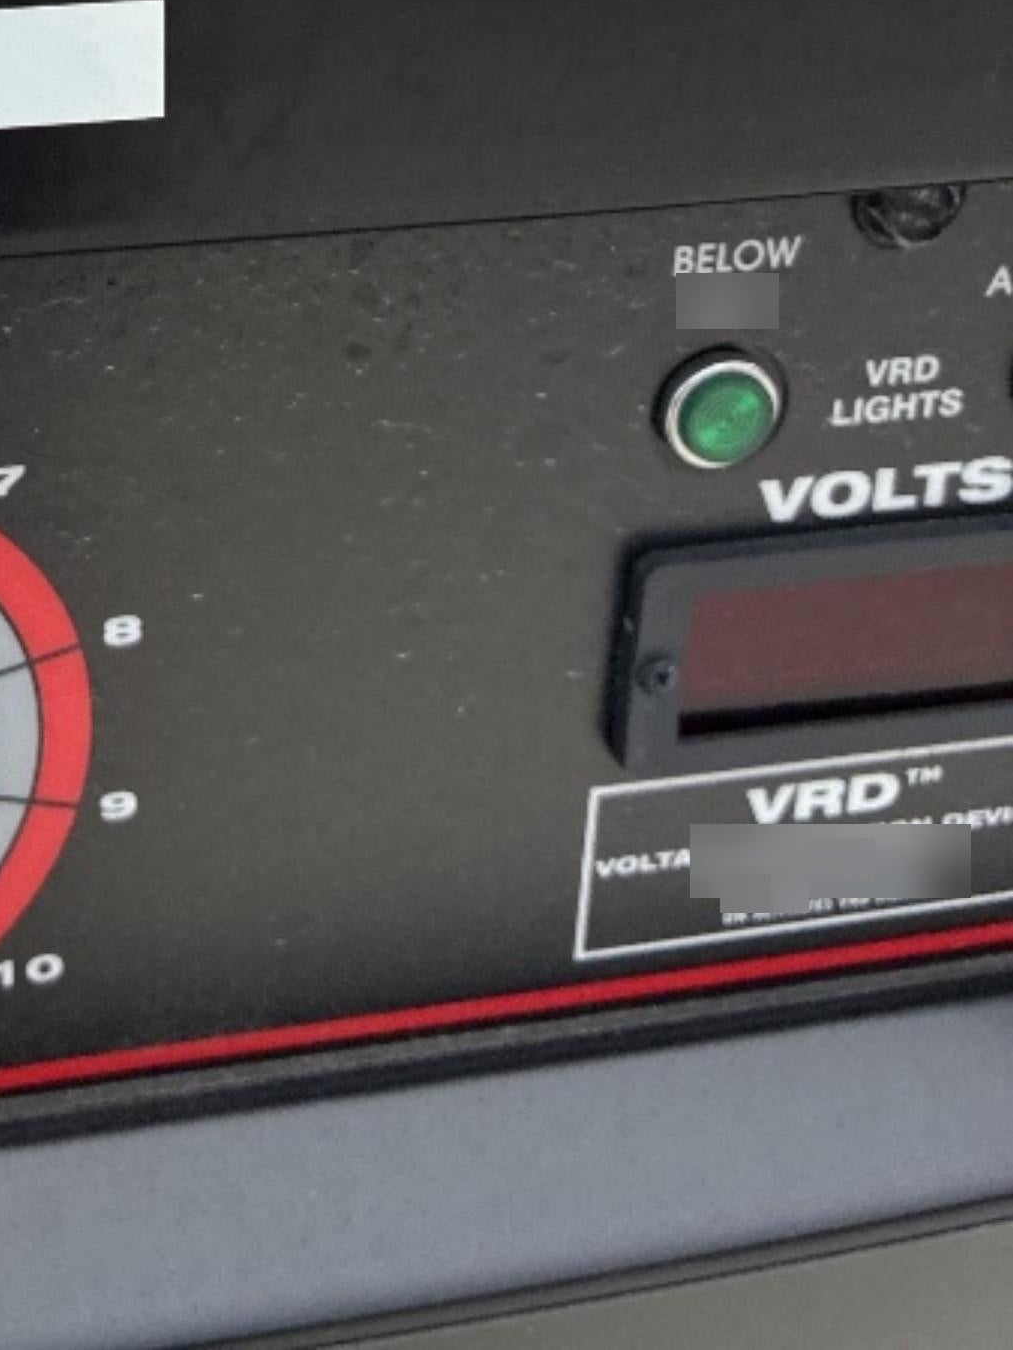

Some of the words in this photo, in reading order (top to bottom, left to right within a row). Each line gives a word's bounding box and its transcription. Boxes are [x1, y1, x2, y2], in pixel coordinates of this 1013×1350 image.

[673, 235, 803, 276] BELOW
[866, 355, 941, 387] VRD
[830, 388, 965, 427] LIGHTS
[758, 455, 1013, 524] VOLTS
[103, 614, 142, 647] 8
[99, 790, 138, 821] 9
[595, 848, 690, 878] VOLTA
